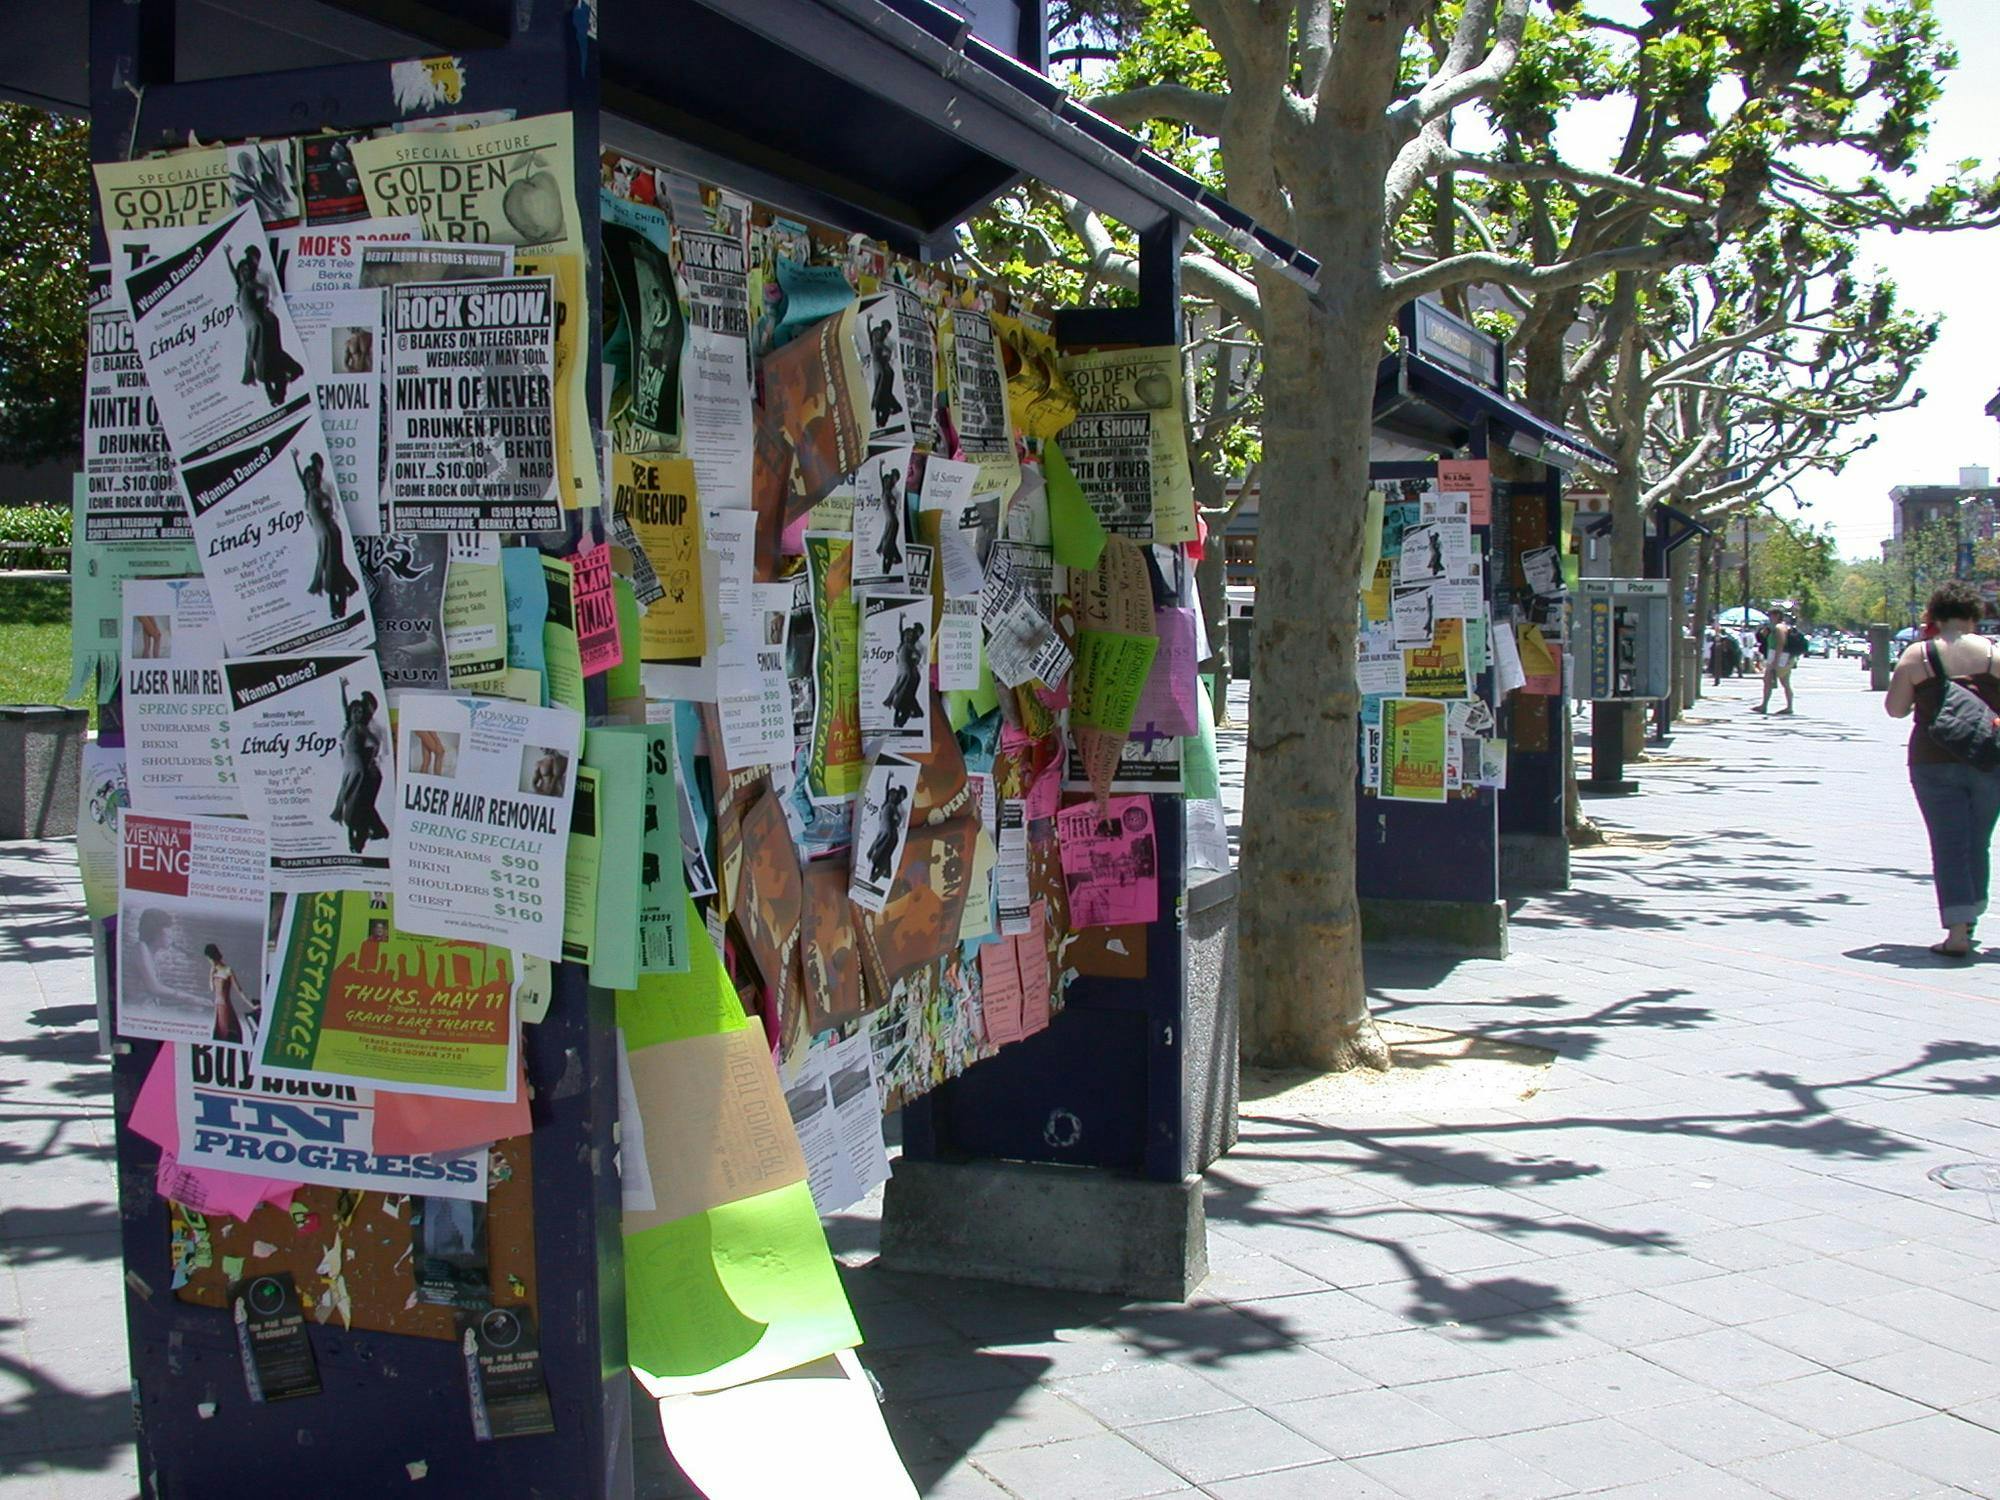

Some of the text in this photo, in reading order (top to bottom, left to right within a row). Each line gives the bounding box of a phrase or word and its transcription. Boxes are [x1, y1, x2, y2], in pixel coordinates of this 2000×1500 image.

[396, 135, 531, 162] SPECIAL LECTURE
[137, 169, 199, 185] SPECIAL
[374, 159, 507, 200] GOLDEN
[298, 235, 351, 257] MOE'S
[683, 240, 713, 268] ROCK
[297, 259, 354, 268] 2476 Tele
[366, 252, 391, 263] DEBUT
[419, 252, 431, 263] IN
[431, 252, 464, 265] STORES
[137, 281, 171, 312] Wanna
[170, 246, 206, 287] Dance?
[318, 270, 352, 280] Berke
[312, 282, 338, 292] (510)
[397, 292, 550, 330] ROCK SHOW.
[92, 322, 133, 354] ROC
[149, 322, 197, 360] Lindy
[202, 304, 234, 333] Hop
[397, 329, 549, 351] @ BLAKES ON TELEGRAPH
[103, 355, 143, 372] BLAKES
[495, 350, 519, 366] MAY
[397, 374, 551, 410] NINTH OF NEVER
[89, 396, 140, 429] NINTH
[322, 420, 359, 432] CIAL!
[408, 416, 551, 438] DRUNKEN PUBLIC
[1102, 419, 1149, 437] SHOW.
[471, 442, 492, 458] 18+
[505, 441, 552, 458] BENTO
[156, 457, 178, 472] 18+
[520, 463, 553, 478] NARC
[1097, 461, 1150, 479] OF NEVER
[197, 446, 272, 507] Wanna Dance?
[428, 483, 511, 497] ROCK OUT WITH
[1115, 481, 1151, 493] PUBLIC
[115, 496, 163, 509] ROCK OUT
[224, 495, 270, 517] Monday Night
[395, 507, 480, 517] BLAKES ON TELEGRAPH
[416, 519, 456, 529] TELEGRAPH
[517, 519, 529, 529] CA
[208, 510, 304, 558] Lindy Hop
[239, 568, 255, 581] May
[271, 567, 289, 581] Gym
[573, 566, 610, 596] SLAM
[468, 589, 487, 598] Board
[1628, 583, 1654, 592] Phone
[575, 591, 614, 639] FINALS
[870, 647, 895, 663] Hop
[1126, 643, 1150, 687] CONCERT
[130, 669, 199, 695] LASER HAIR
[237, 661, 318, 705] Wanna Dance?
[764, 691, 780, 701] $90
[138, 703, 188, 716] SPRING
[262, 710, 305, 721] Monday Night
[476, 709, 529, 726] ADVANCED
[760, 704, 783, 714] $120
[140, 723, 211, 733] UNDERARMS
[761, 717, 785, 727] $150
[761, 729, 785, 740] $160
[141, 740, 178, 749] BIKINI
[240, 732, 337, 759] Lindy Hop
[141, 757, 212, 766] SHOULDERS
[142, 774, 184, 783] CHEST
[405, 783, 557, 835] LASER HAIR REMOVAL
[124, 828, 180, 848] VIENNA
[410, 820, 543, 855] SPRING SPECIAL!
[124, 843, 192, 876] TENG
[408, 841, 539, 872] UNDERARMS $90
[408, 859, 540, 889] BIKINI $120
[408, 876, 542, 906] SHOULDERS $150
[408, 894, 453, 908] CHEST
[494, 903, 543, 923] $160
[344, 983, 421, 1007] THURS.
[430, 991, 479, 1011] MAY
[485, 993, 505, 1009] 11
[346, 1010, 393, 1024] GRAND
[397, 1016, 433, 1029] LAKE
[435, 1018, 497, 1033] THEATER
[194, 1093, 359, 1144] IN
[194, 1129, 478, 1183] PROGRESS
